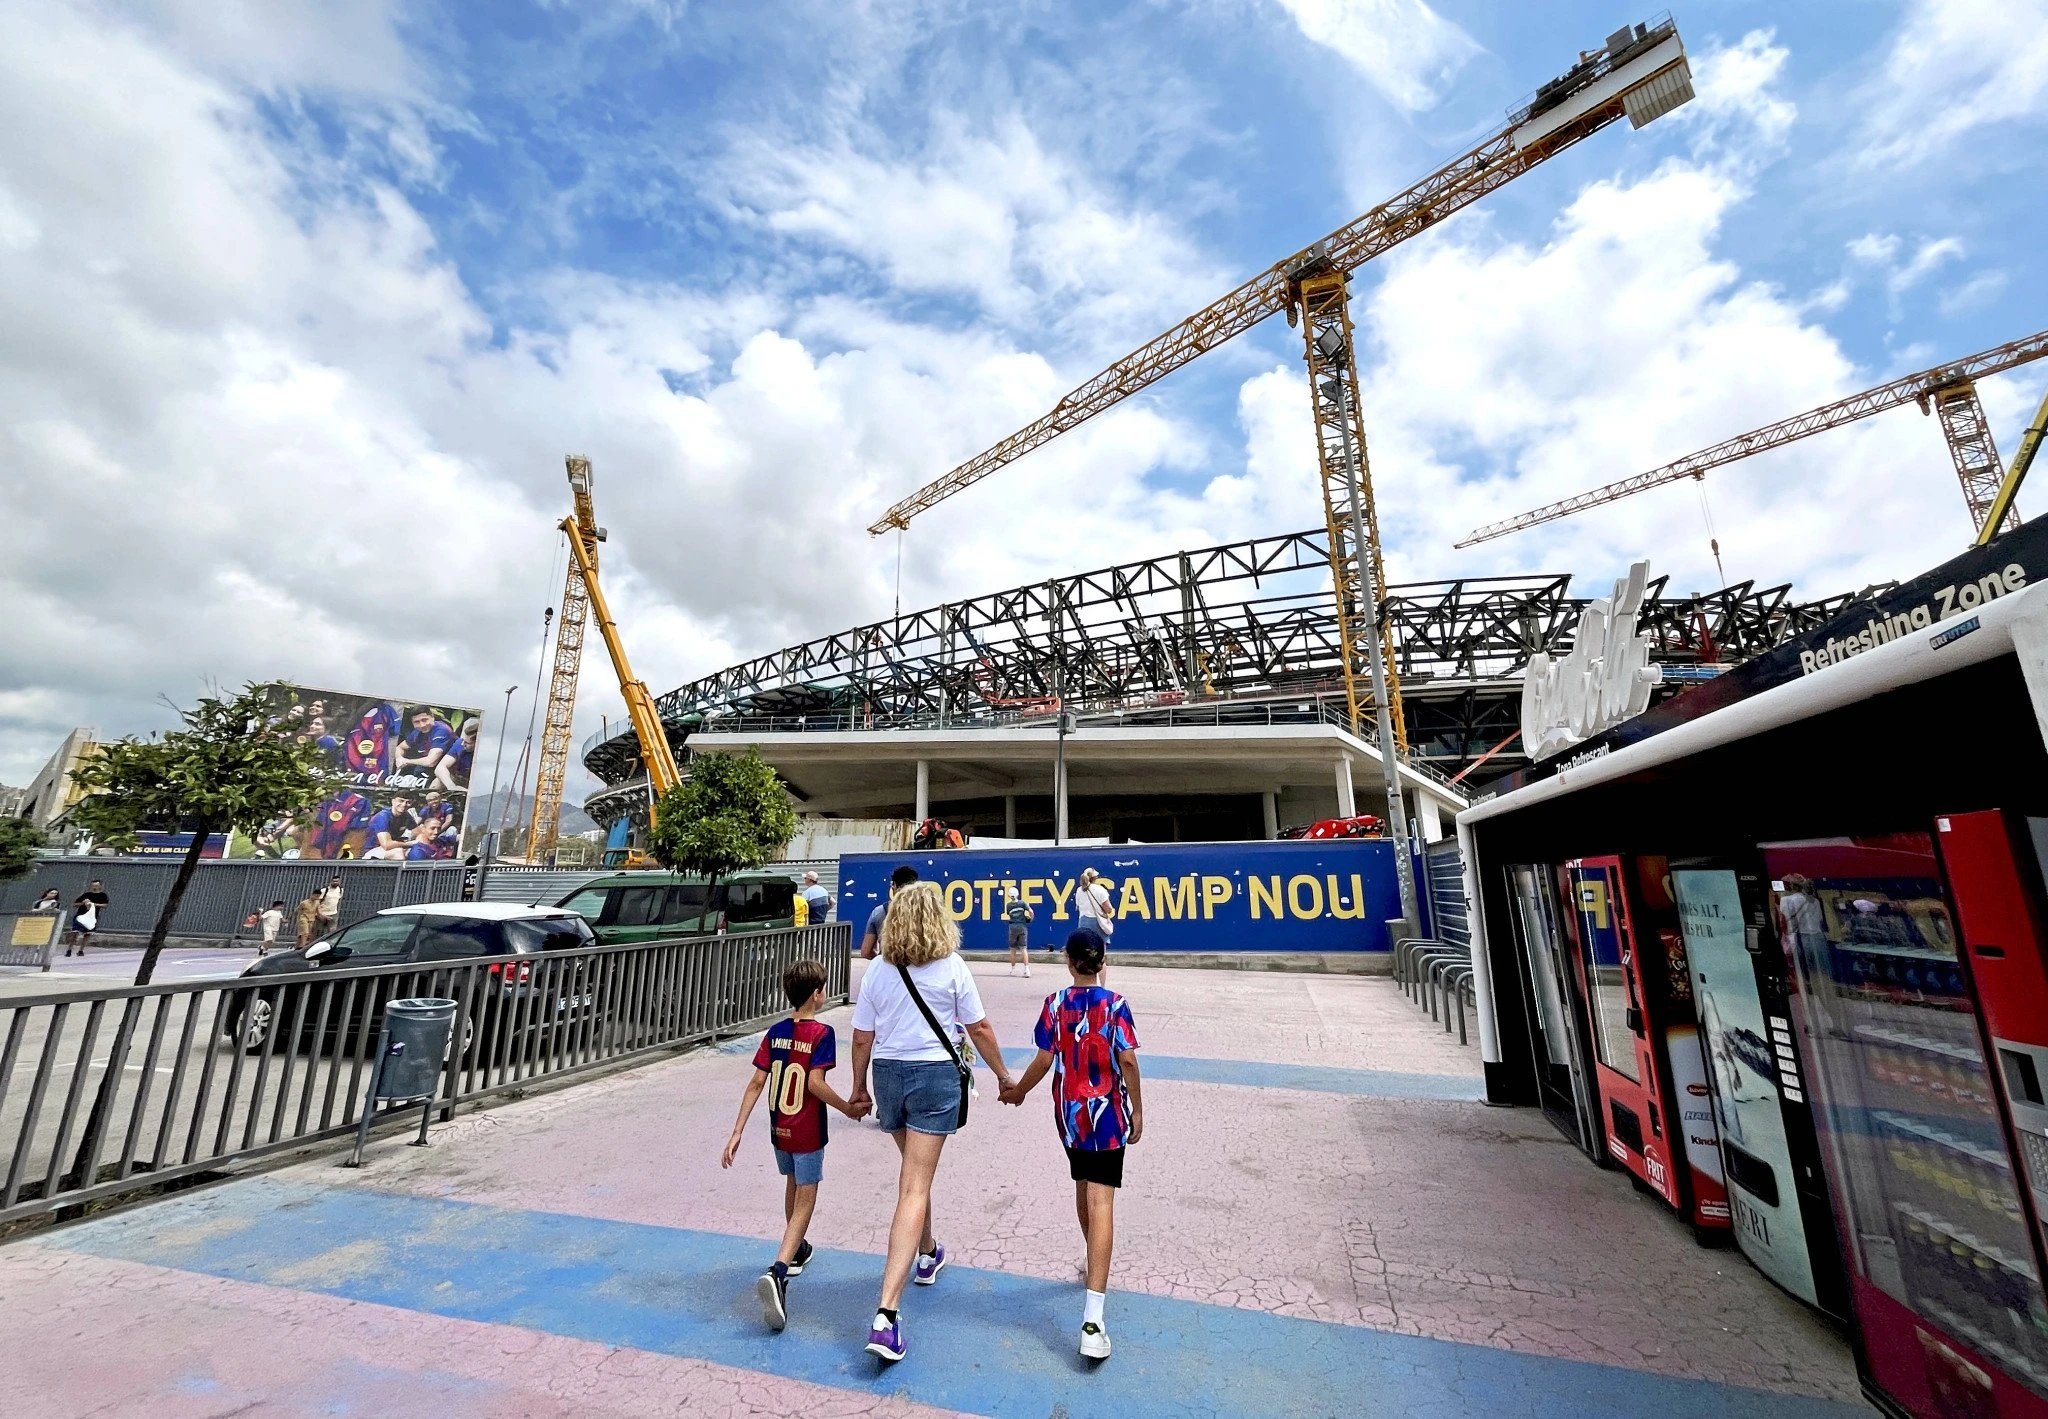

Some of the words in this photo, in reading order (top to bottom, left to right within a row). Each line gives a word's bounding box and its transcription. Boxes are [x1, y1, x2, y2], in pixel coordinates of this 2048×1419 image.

[1800, 604, 1932, 676] Refreshing
[1934, 563, 2027, 621] Zone
[889, 877, 1076, 921] OTIFY
[1248, 873, 1366, 920] NOU
[770, 1059, 806, 1116] 10
[1646, 1156, 1664, 1184] FRIT
